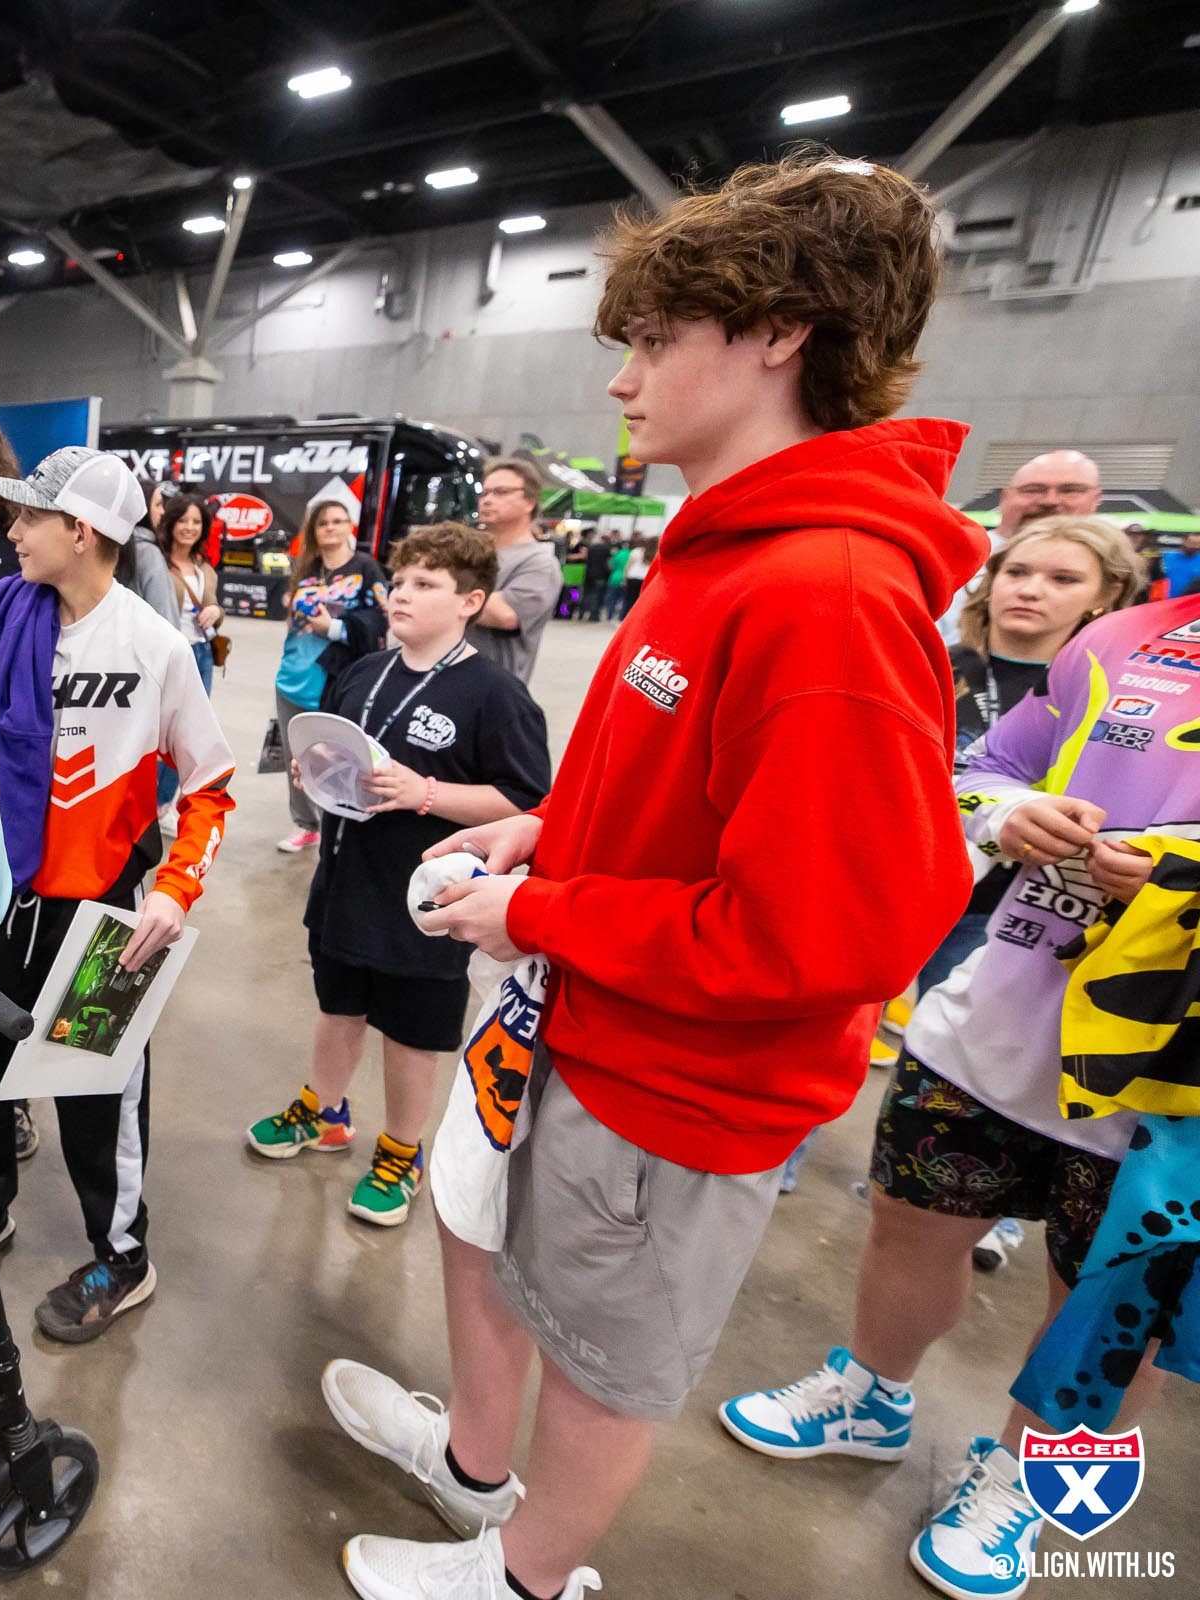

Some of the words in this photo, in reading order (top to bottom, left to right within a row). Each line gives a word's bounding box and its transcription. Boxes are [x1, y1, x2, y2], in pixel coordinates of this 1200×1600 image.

[282, 440, 369, 473] KTM
[632, 645, 689, 692] Letko
[51, 672, 142, 709] HOR
[640, 680, 674, 704] CYCLES
[1118, 673, 1192, 695] SHOWA
[1102, 733, 1147, 751] LOCK
[1108, 724, 1155, 741] QUAD
